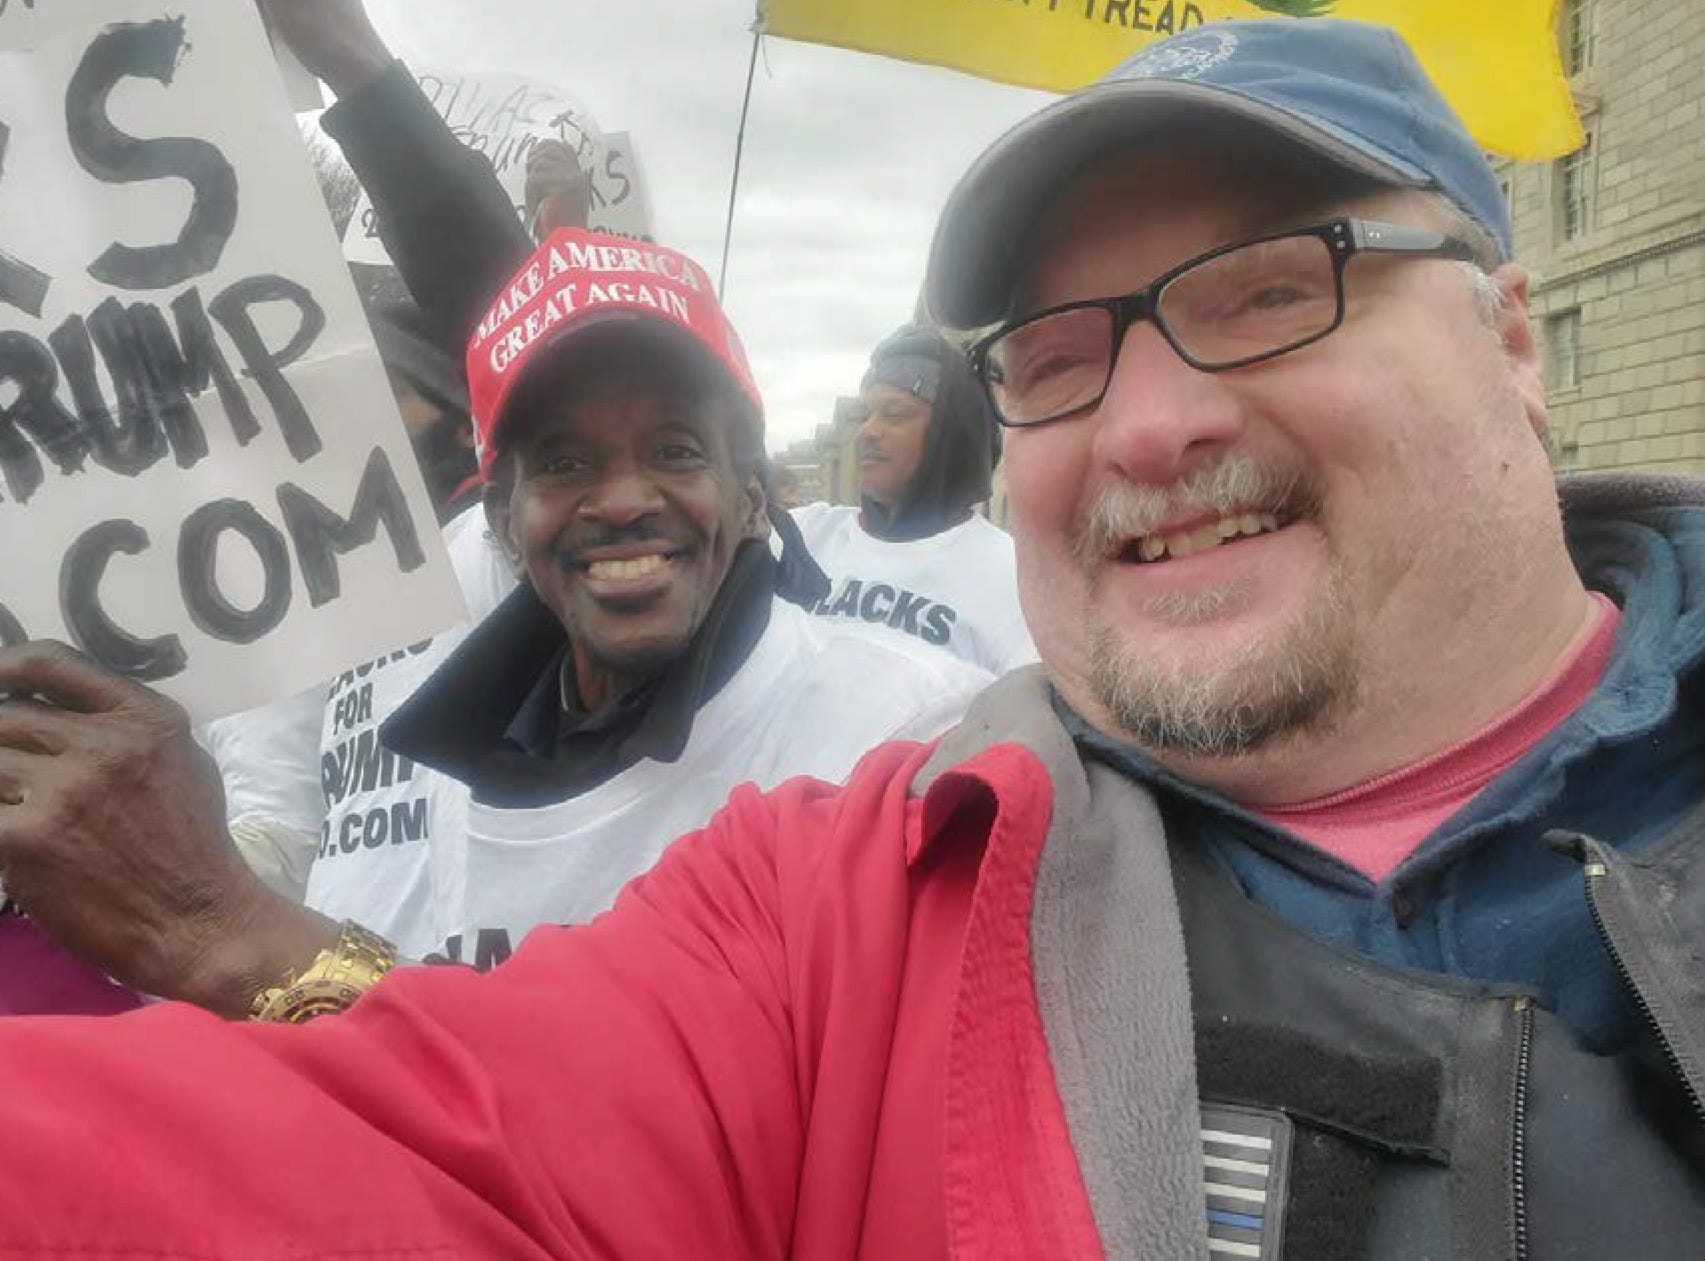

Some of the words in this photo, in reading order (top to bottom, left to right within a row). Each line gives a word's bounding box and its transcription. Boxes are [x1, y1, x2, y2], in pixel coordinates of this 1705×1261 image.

[472, 262, 545, 349] MAKE
[548, 242, 701, 292] AMERICA
[490, 284, 578, 373] GREAT
[587, 282, 691, 325] AGAIN
[0, 274, 326, 505] RUMP
[333, 683, 373, 735] FOR
